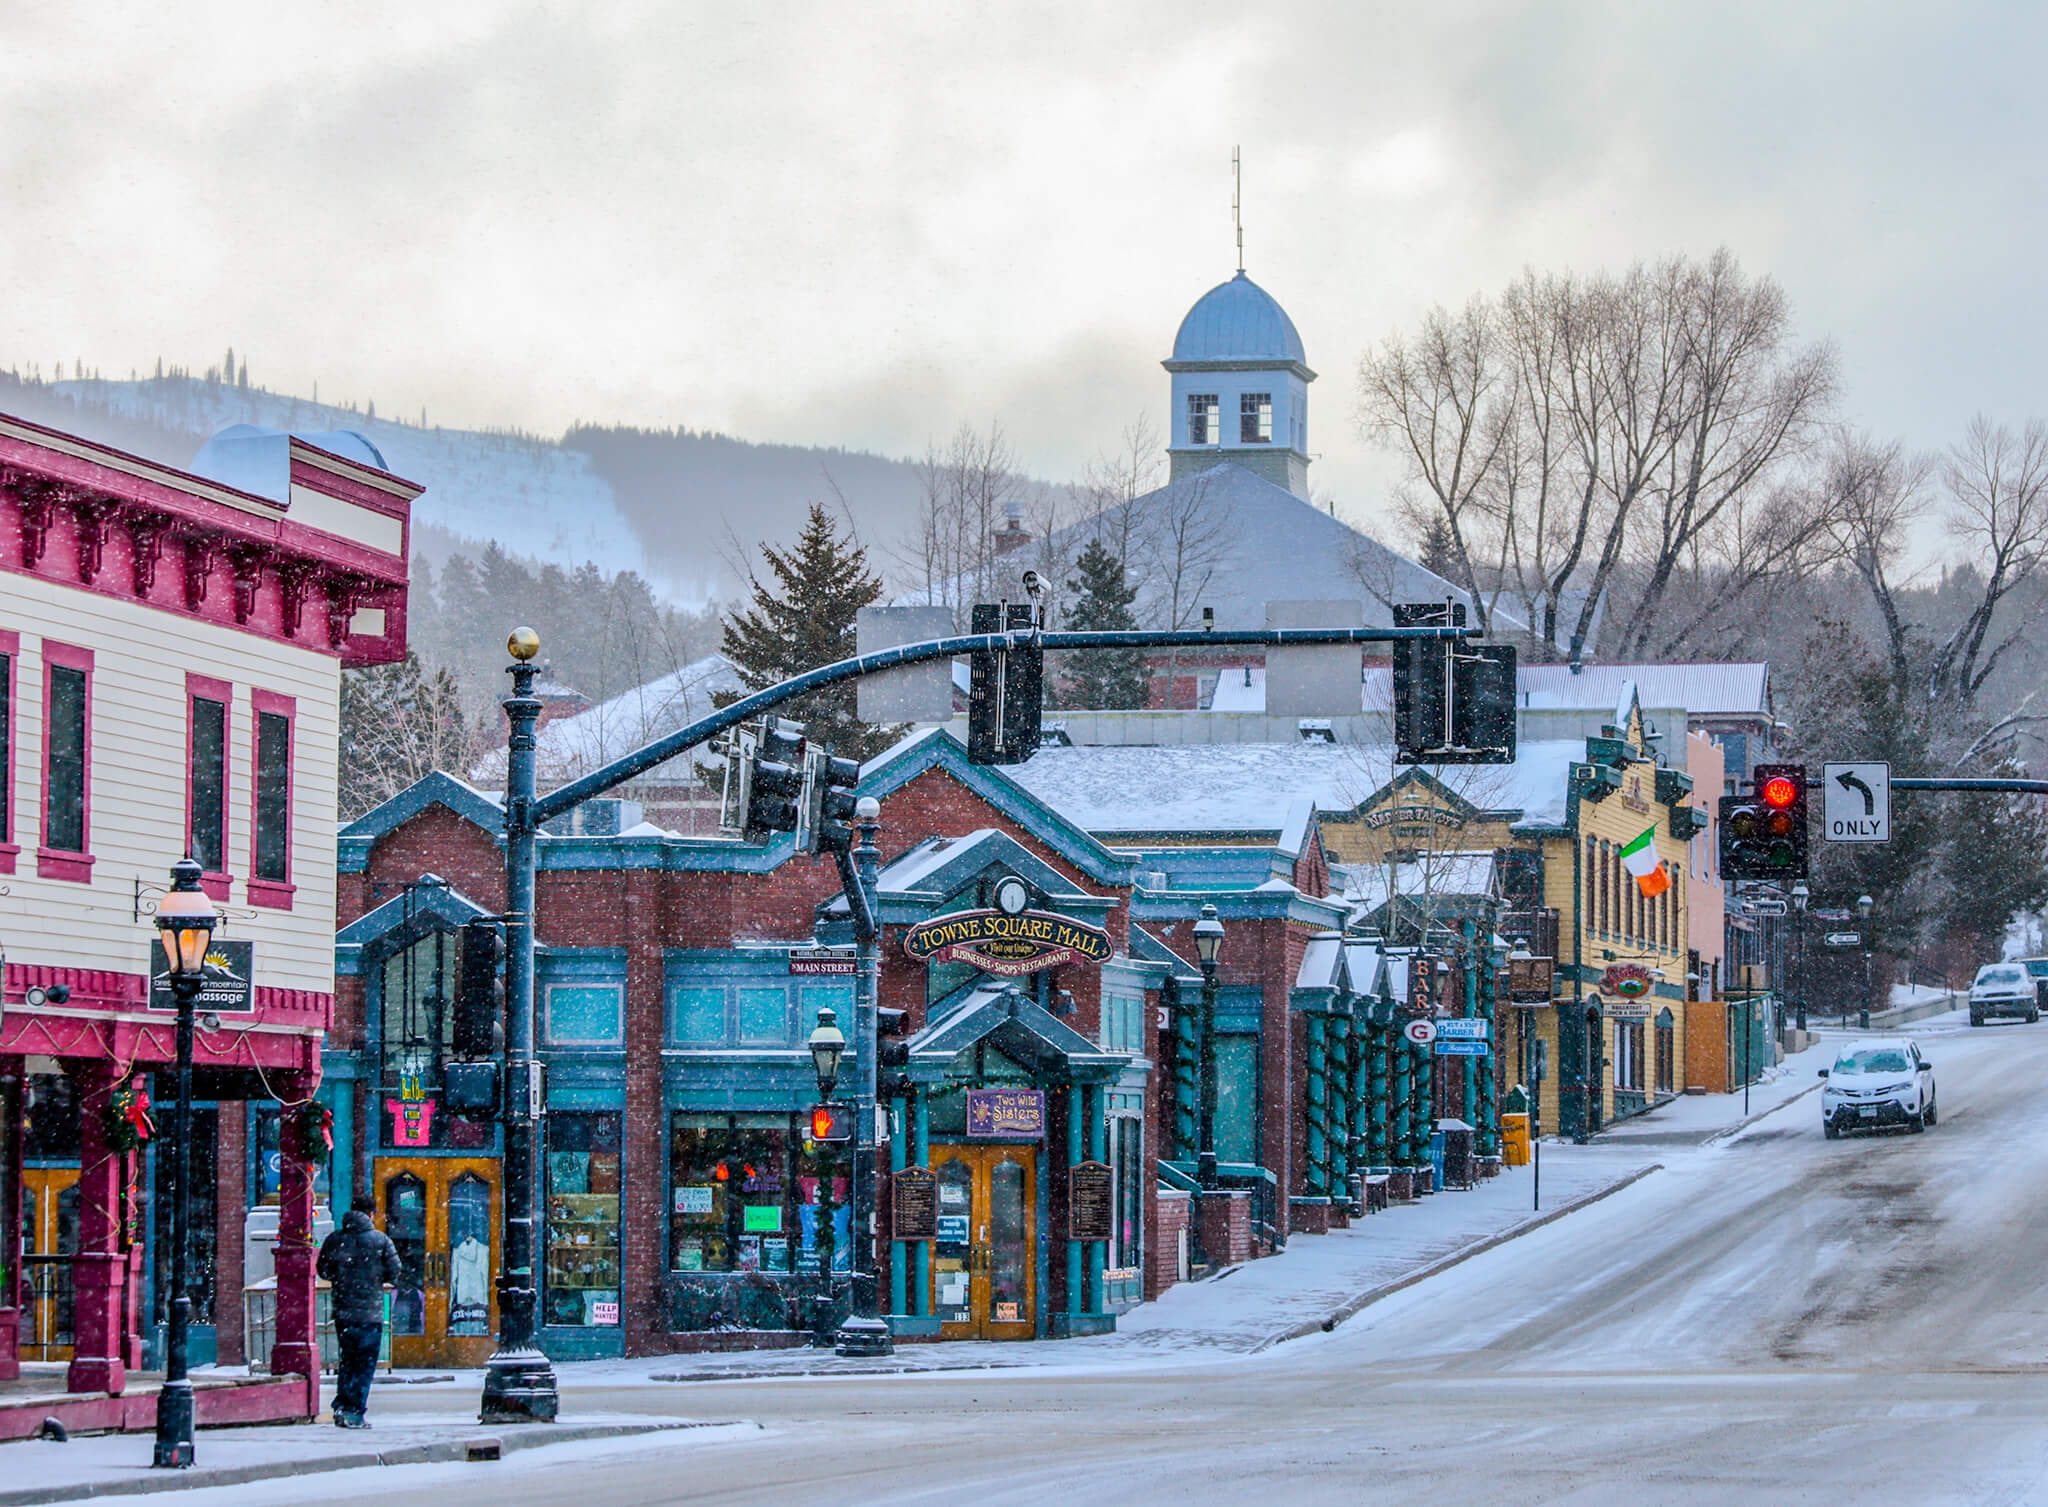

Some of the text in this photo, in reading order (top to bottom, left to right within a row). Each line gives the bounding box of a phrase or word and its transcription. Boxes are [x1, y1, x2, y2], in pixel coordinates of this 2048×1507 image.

[1365, 809, 1414, 828] NAPER
[1833, 820, 1881, 836] ONLY
[919, 917, 1100, 956] TOWNE SQUARE MALL
[796, 962, 820, 973] MAIN
[820, 962, 855, 973] STREET
[951, 947, 1071, 975] BUSINESSES SHOPS RESTAURANTS
[209, 980, 249, 989] mountain
[1413, 960, 1430, 1009] BAR
[1410, 1023, 1429, 1039] G
[995, 1094, 1038, 1106] Two Wild
[992, 1105, 1040, 1122] Sisters
[595, 1304, 617, 1312] HELP
[594, 1313, 617, 1321] WANTED
